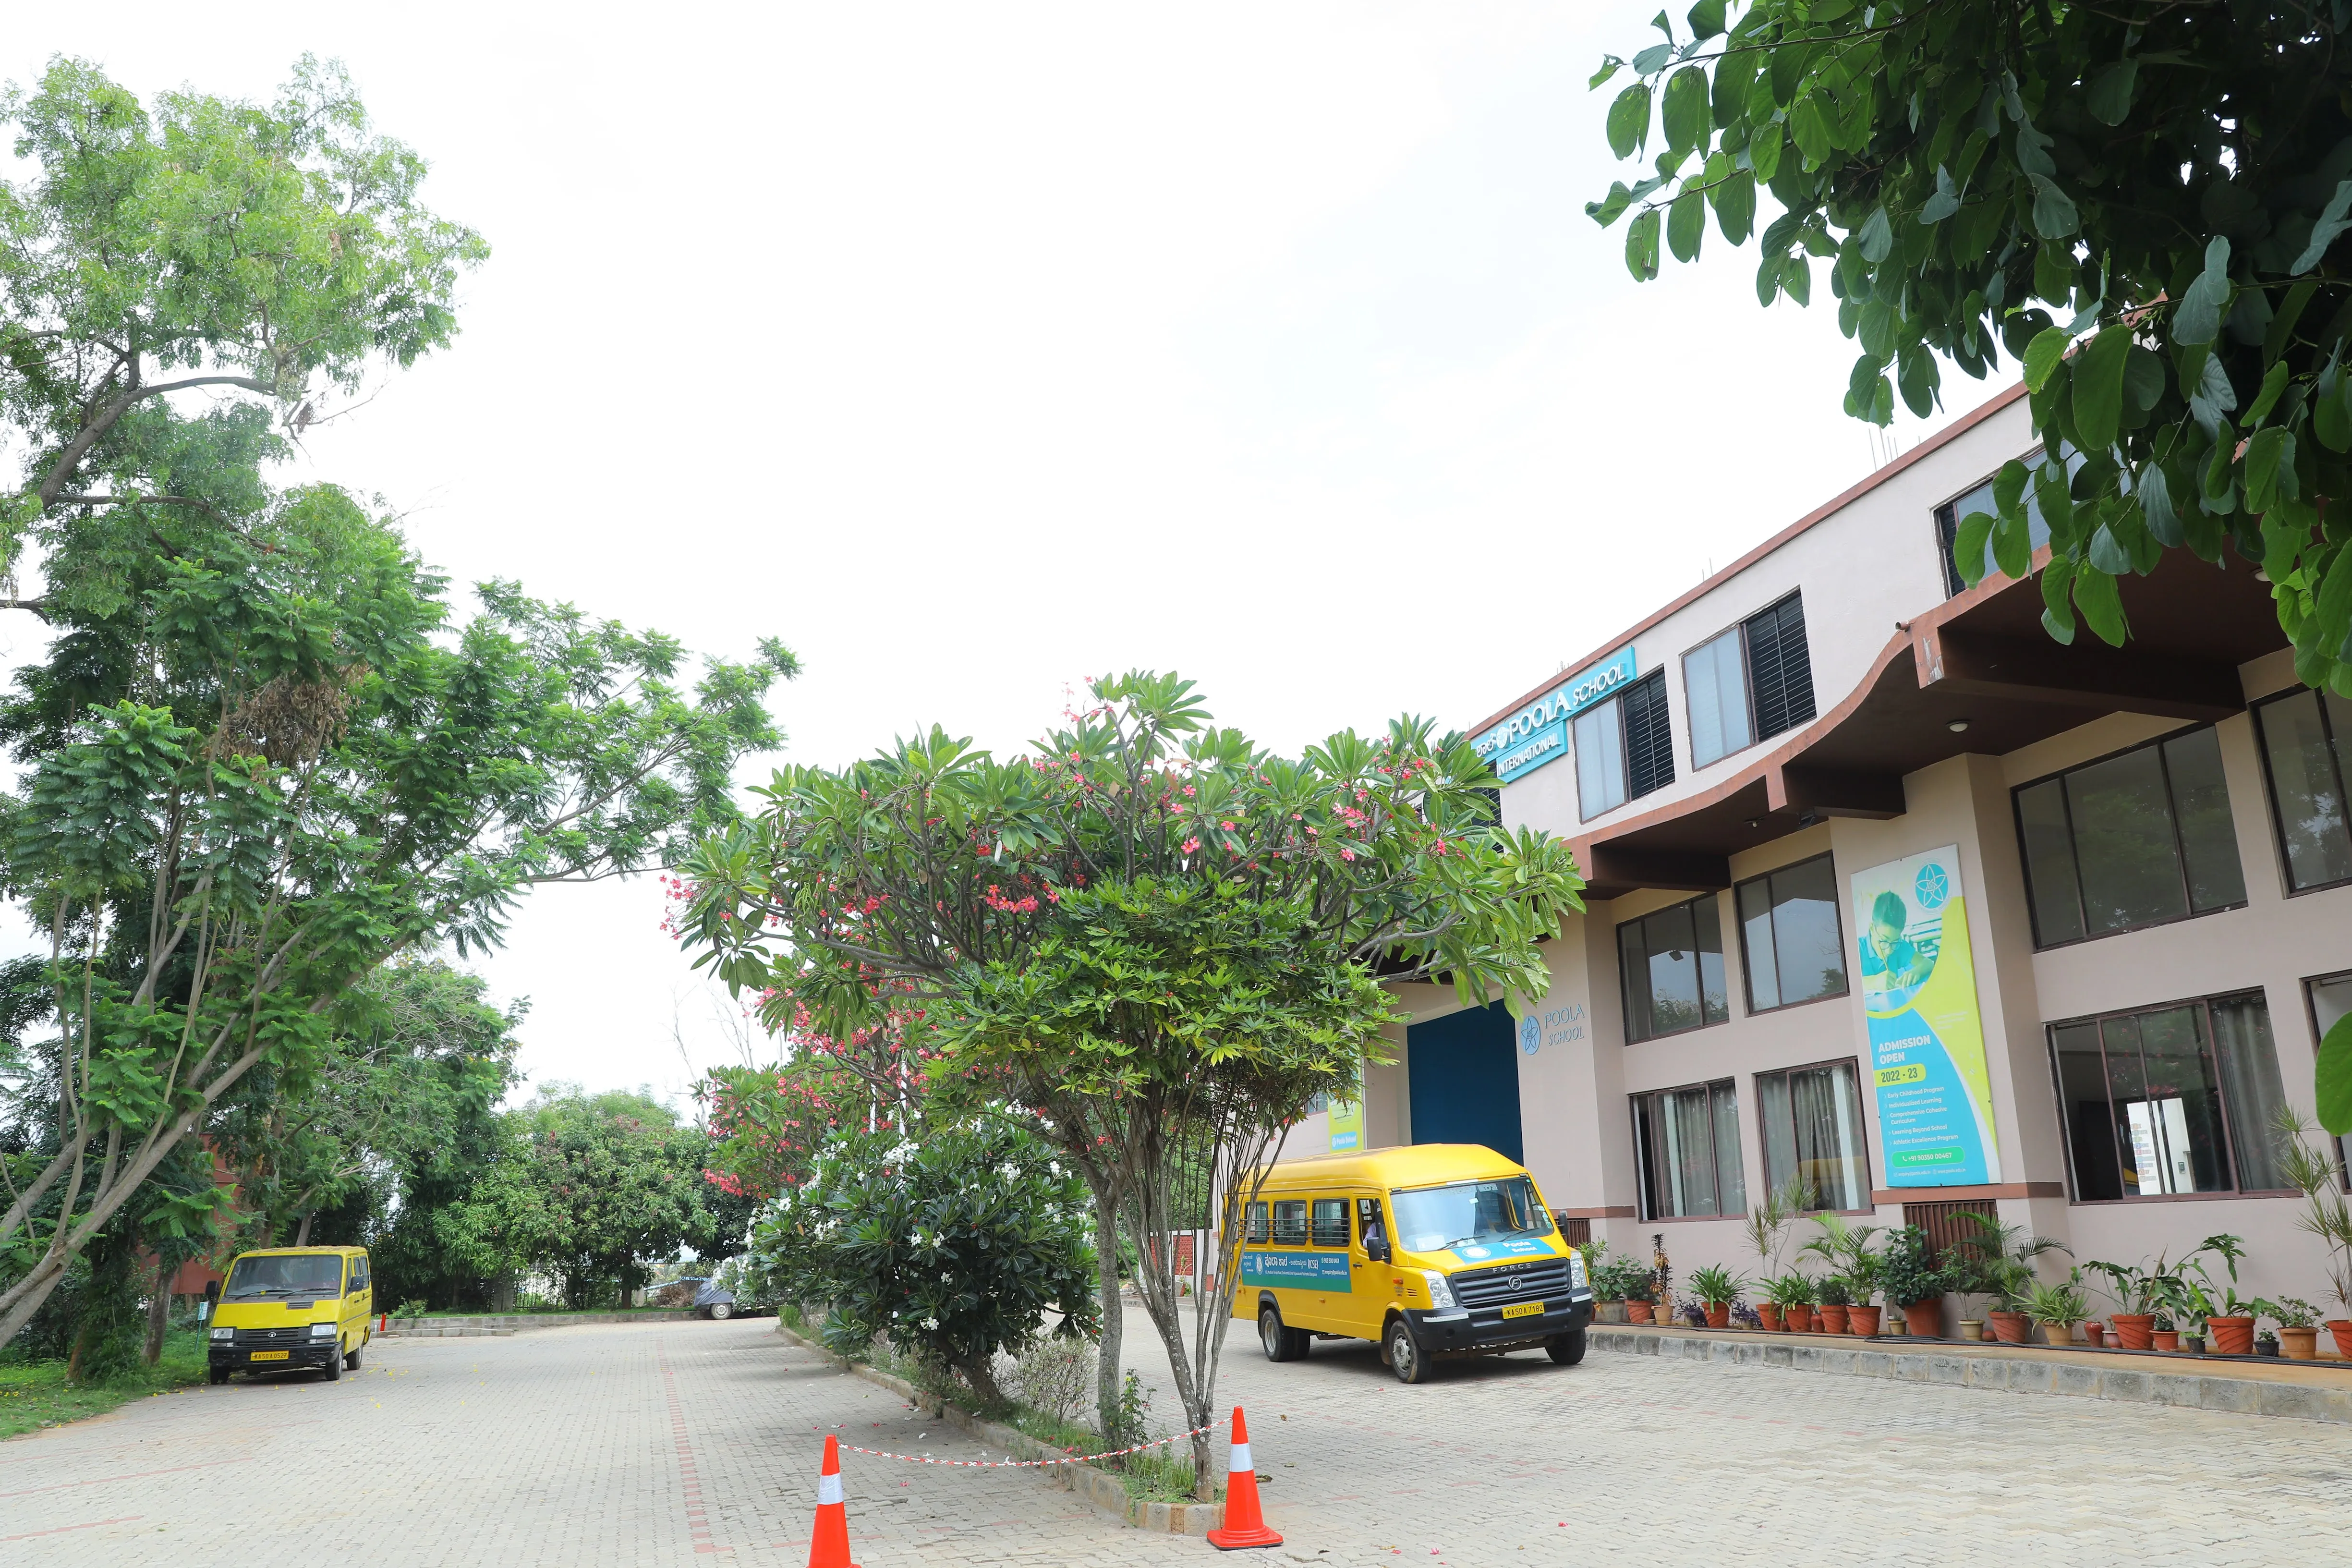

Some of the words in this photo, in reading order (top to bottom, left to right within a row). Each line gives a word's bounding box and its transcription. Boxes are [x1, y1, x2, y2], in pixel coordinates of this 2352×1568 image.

[1509, 692, 1571, 742] POOLA
[1573, 663, 1626, 706] SCHOOL
[1496, 733, 1560, 777] INTERNATIONAL
[1545, 1004, 1585, 1029] POOLA
[1549, 1026, 1584, 1046] SCHOOL
[1879, 1035, 1931, 1053] ADMISSION
[1879, 1052, 1905, 1064] OPEN
[1881, 1070, 1901, 1082] 2022
[1907, 1067, 1917, 1079] 23
[1900, 1089, 1923, 1097] Childhood
[1890, 1109, 1925, 1118] Comprehensive
[1308, 1258, 1319, 1270] (ICSE)
[1492, 1263, 1532, 1273] FORCE
